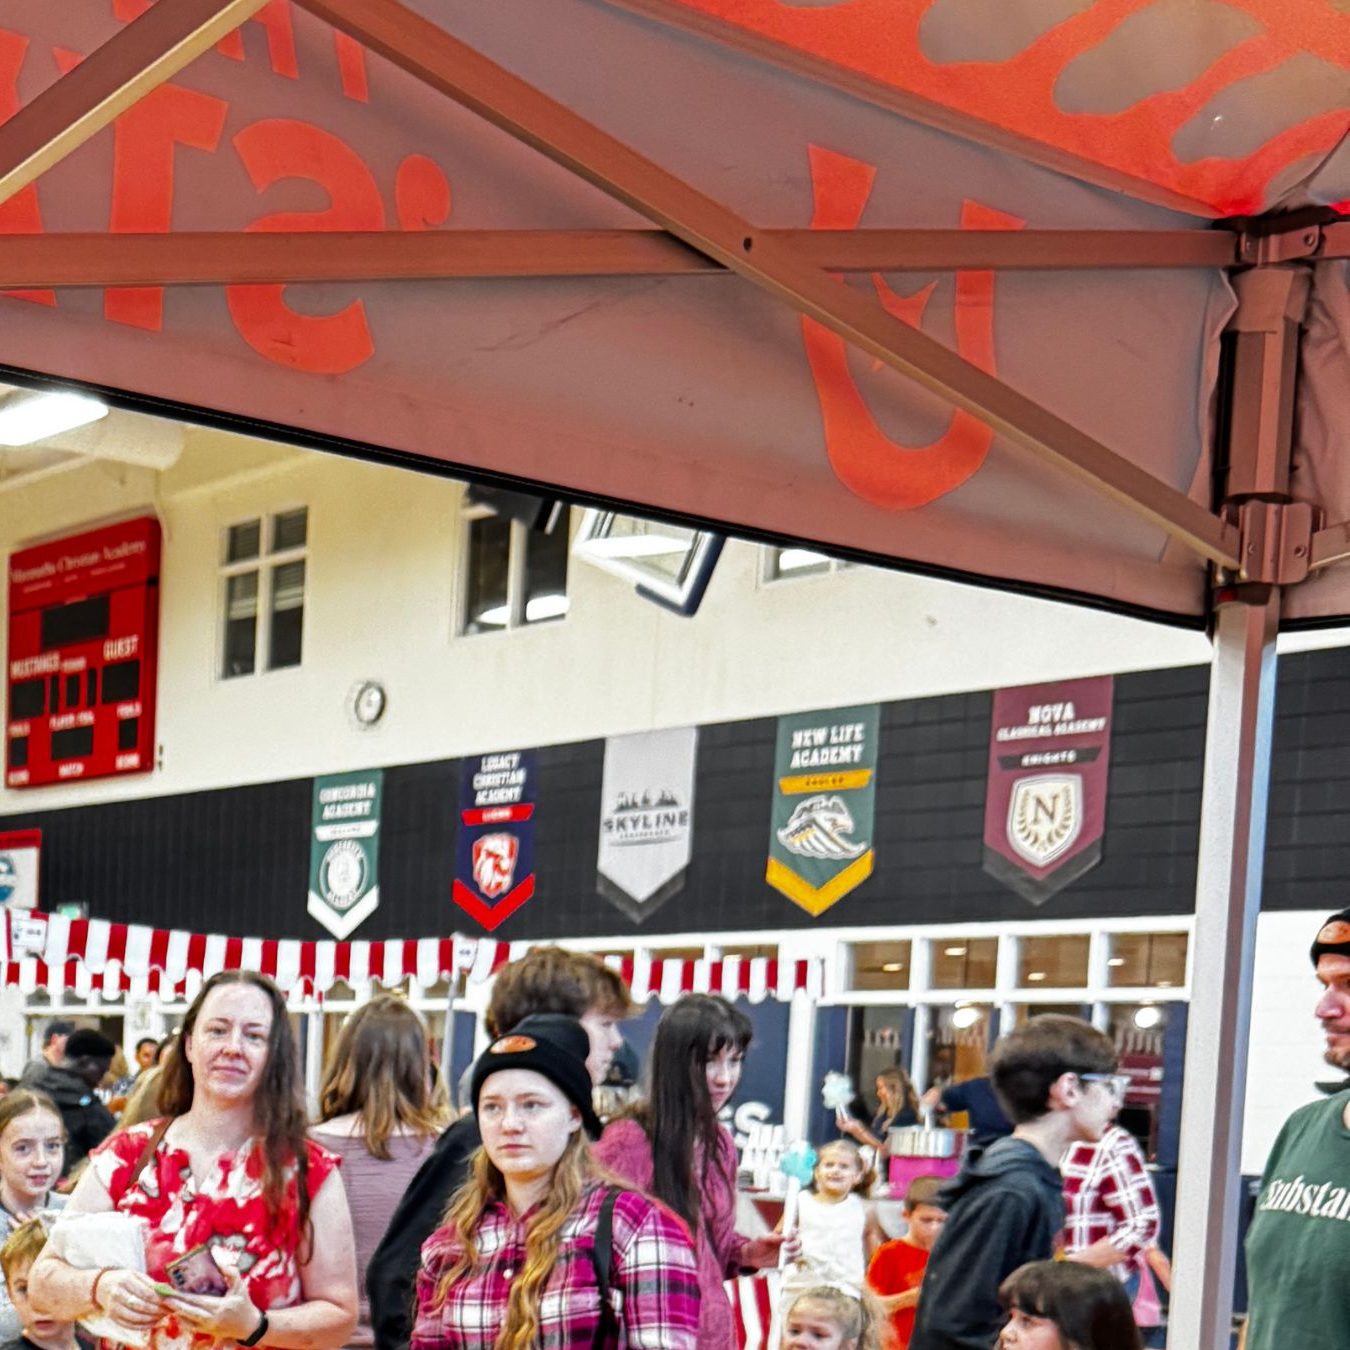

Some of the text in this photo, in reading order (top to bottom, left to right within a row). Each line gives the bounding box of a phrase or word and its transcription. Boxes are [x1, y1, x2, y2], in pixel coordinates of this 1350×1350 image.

[104, 634, 139, 661] GUEST
[1027, 702, 1075, 725] NOVA
[792, 722, 865, 749] NEW LIFE
[480, 752, 521, 774] LEGACY
[790, 743, 865, 769] ACADEMY
[473, 767, 527, 791] CHRISTIAN
[474, 784, 524, 807] ACADEMY
[603, 809, 689, 833] SKYLINE
